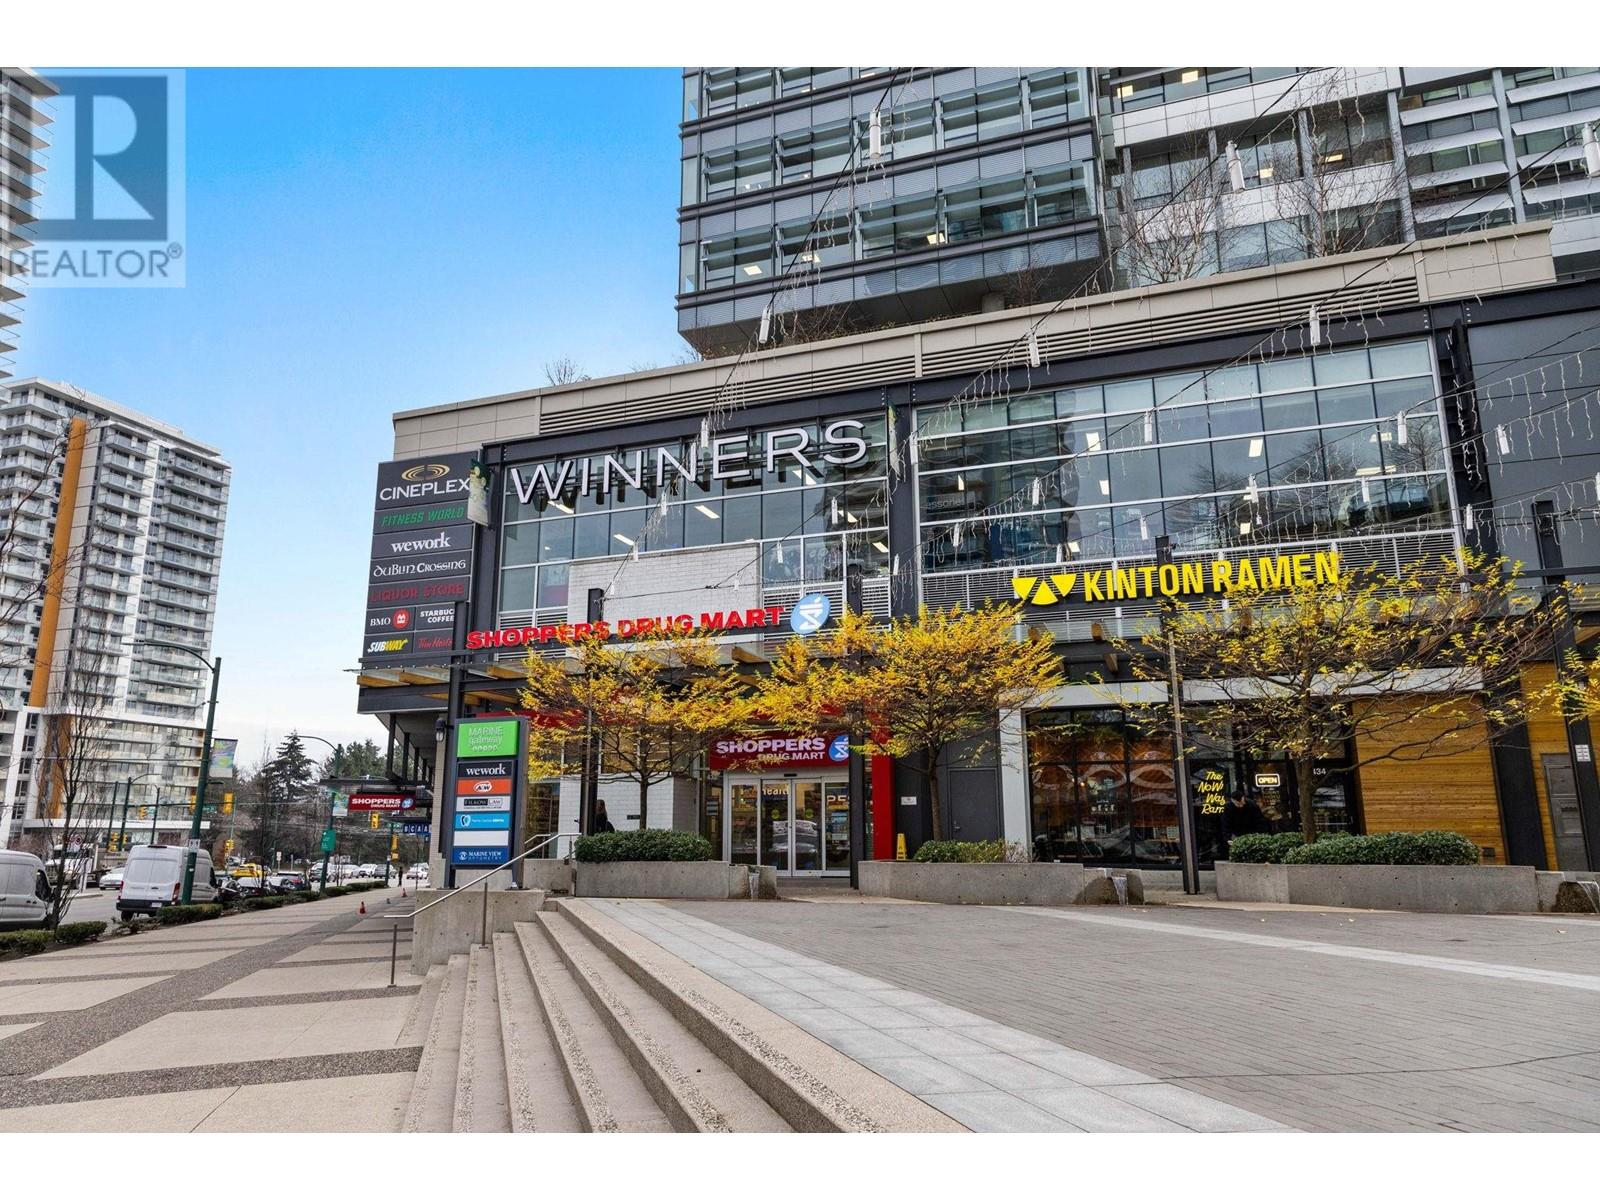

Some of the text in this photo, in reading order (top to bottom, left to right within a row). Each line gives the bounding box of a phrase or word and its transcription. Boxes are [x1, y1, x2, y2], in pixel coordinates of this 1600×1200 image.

[511, 420, 867, 504] WINNERS
[380, 477, 471, 501] CINEPLEX
[382, 506, 464, 527] FITNESS WORLD
[391, 531, 451, 553] wework
[1083, 551, 1339, 602] KINTON RAMEN
[369, 583, 465, 602] LIQUOR STORE
[370, 617, 391, 627] BMO
[466, 606, 784, 650] SHOPPERS DRUG MART
[367, 638, 408, 653] SUBWAY
[468, 726, 503, 737] MARINE
[716, 737, 826, 755] SHOPPERS
[757, 751, 826, 761] DRUG MART
[466, 763, 506, 775] wework
